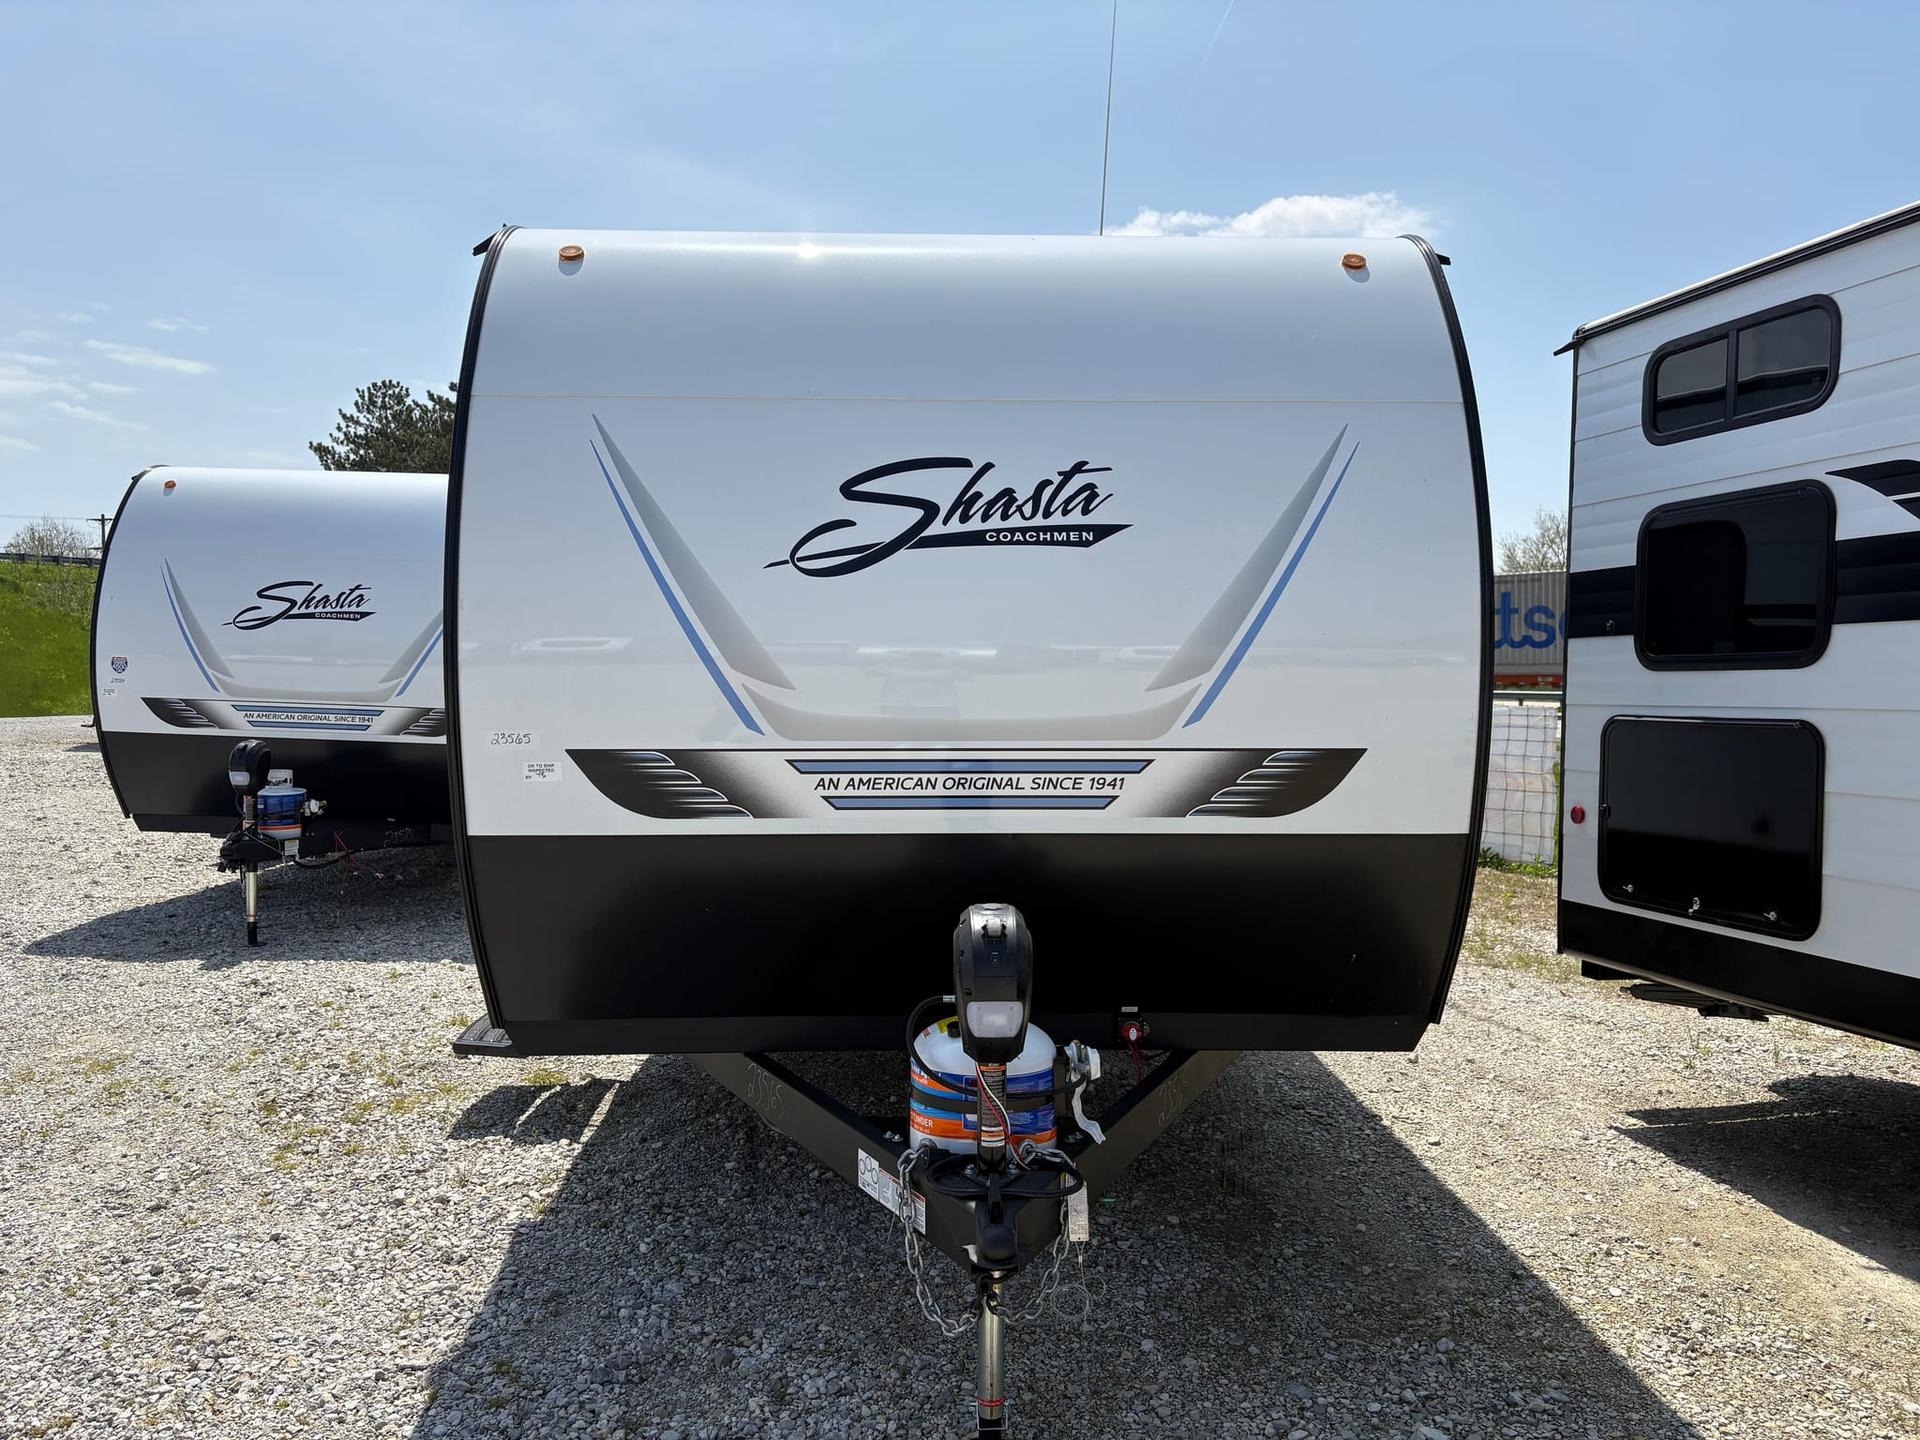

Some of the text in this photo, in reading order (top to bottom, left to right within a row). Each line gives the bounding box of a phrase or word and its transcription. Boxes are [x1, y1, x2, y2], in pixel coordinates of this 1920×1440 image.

[790, 457, 1113, 577] Shasta
[985, 531, 1095, 543] COACHMEN
[233, 581, 371, 630] Shasta
[256, 713, 295, 721] AMERICAN
[297, 714, 332, 722] ORIGINAL
[358, 716, 374, 724] 1941
[490, 732, 532, 746] 23565
[814, 777, 1126, 791] AN AMERICAN ORIGINAL SINCE 1941
